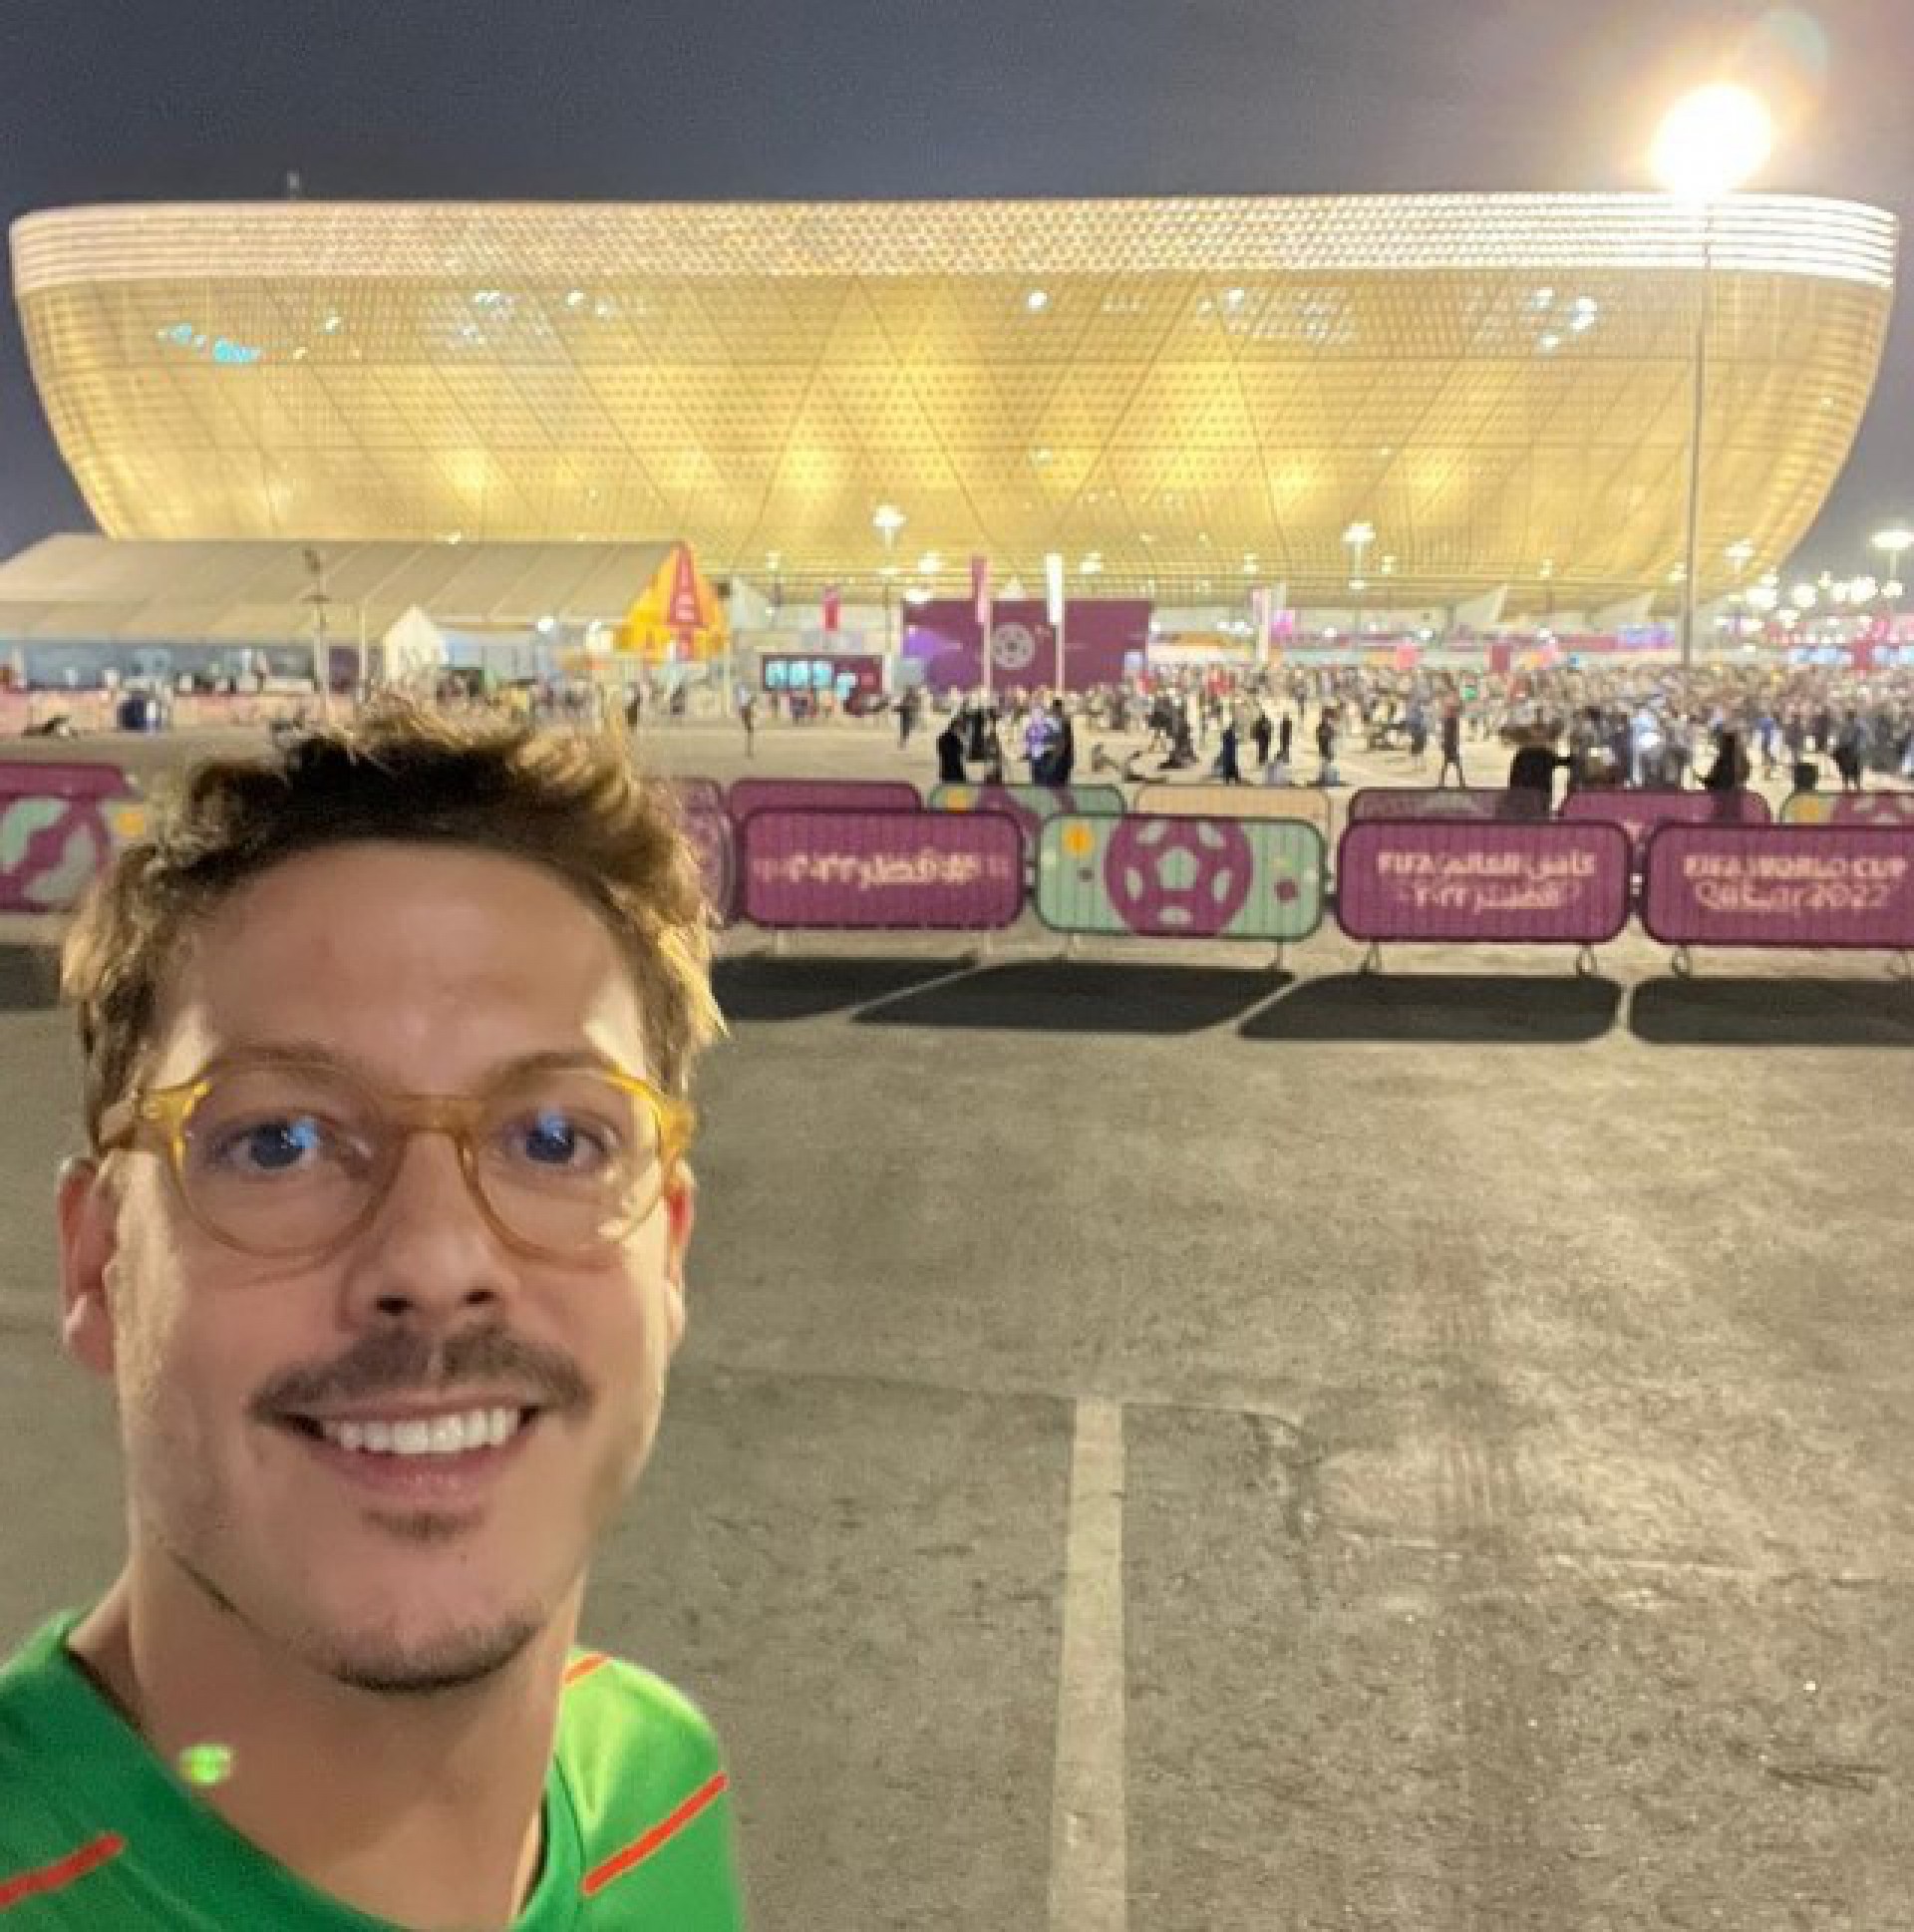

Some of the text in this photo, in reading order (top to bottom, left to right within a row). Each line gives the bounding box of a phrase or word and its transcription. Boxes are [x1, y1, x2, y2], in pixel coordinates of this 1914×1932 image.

[1378, 852, 1434, 877] FIFA
[1683, 854, 1909, 879] FIFA WORLD CUP
